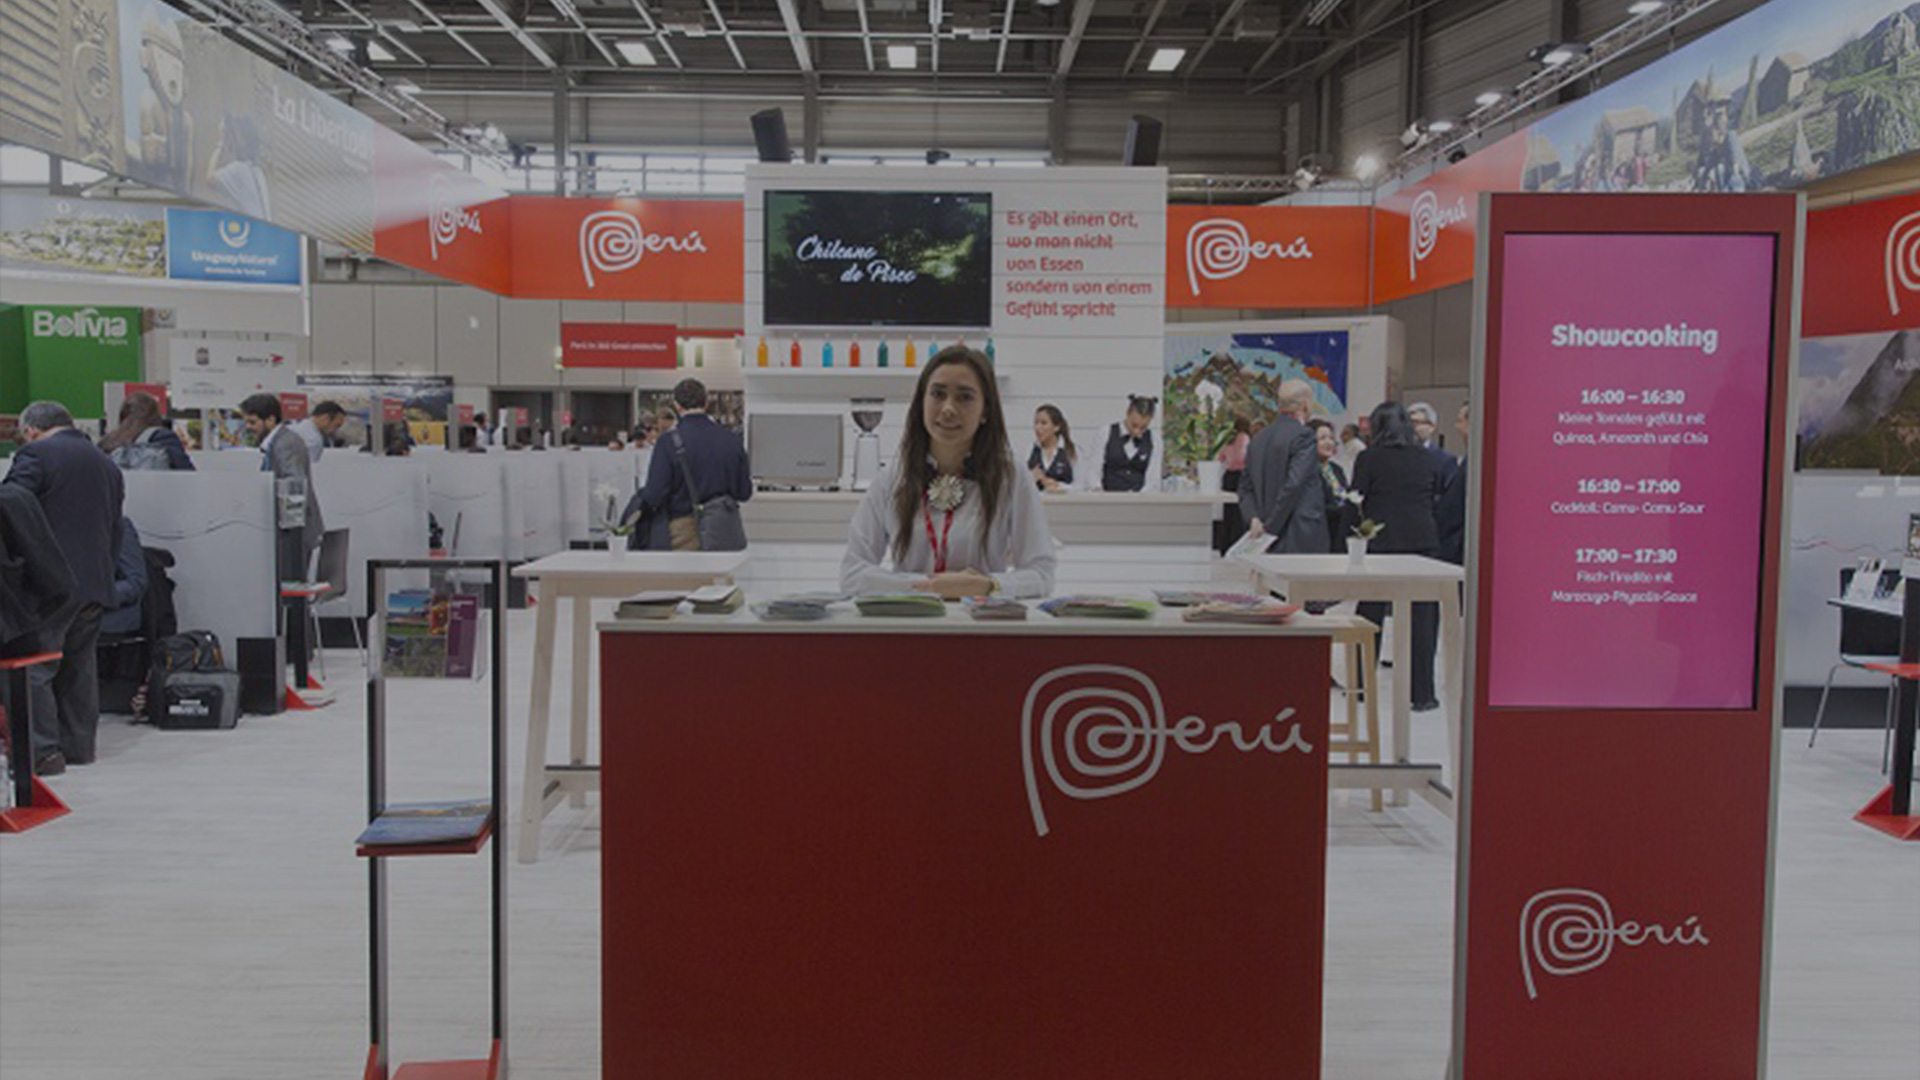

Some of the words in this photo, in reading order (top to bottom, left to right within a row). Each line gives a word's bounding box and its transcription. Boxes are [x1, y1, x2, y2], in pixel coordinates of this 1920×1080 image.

[1006, 211, 1025, 226] Es
[1028, 210, 1058, 230] gibt
[1062, 211, 1105, 227] einen
[1108, 211, 1138, 228] Ort,
[579, 210, 707, 289] Perú
[1006, 236, 1032, 248] wo
[1035, 236, 1070, 248] man
[1074, 234, 1113, 248] nicht
[1006, 259, 1036, 271] von
[1040, 257, 1084, 271] Essen
[1186, 217, 1313, 296] Perú
[1006, 279, 1068, 294] sondern
[1072, 283, 1102, 294] von
[1106, 279, 1152, 295] einem
[1006, 301, 1058, 319] Gefühl
[1061, 302, 1116, 319] spricht
[1552, 323, 1718, 354] Showcooking
[1581, 389, 1625, 404] 16:00
[1641, 389, 1685, 404] 16:30
[1578, 479, 1621, 494] 16:30
[1637, 479, 1680, 494] 17:00
[1576, 549, 1618, 563] 17:00
[1634, 549, 1677, 563] 17:30
[1021, 663, 1313, 837] Perú
[1519, 887, 1710, 1000] Perú
